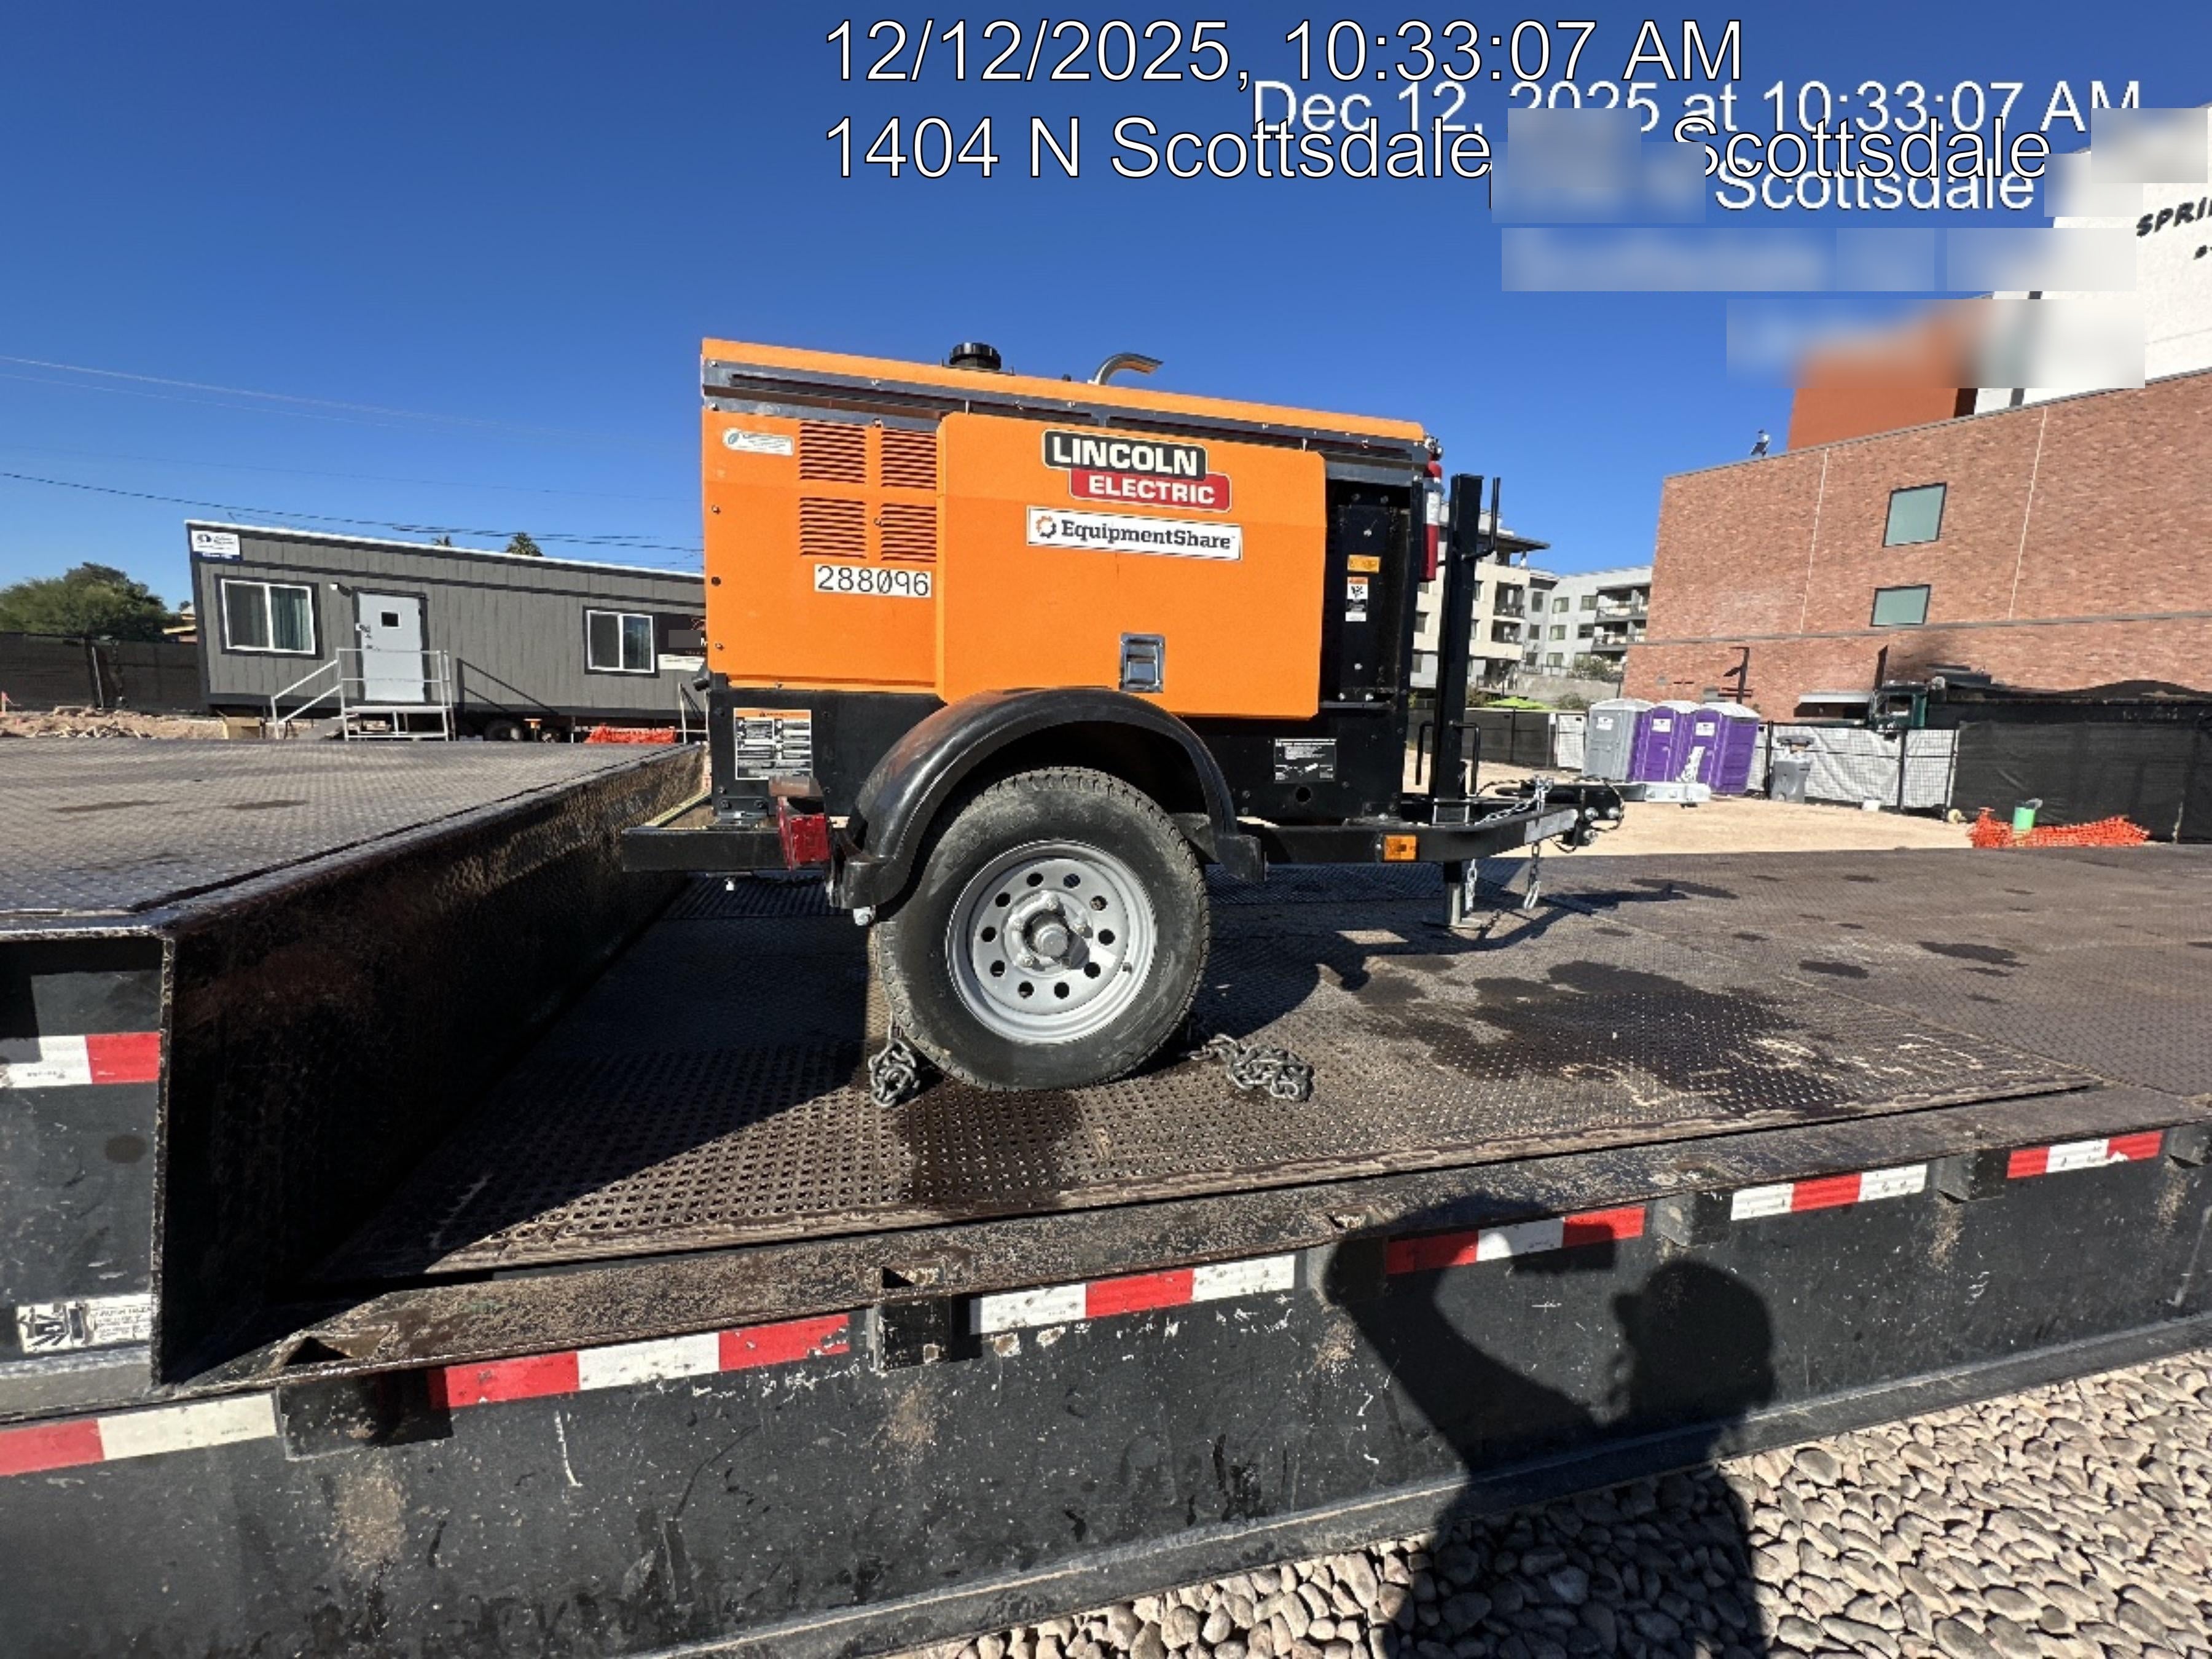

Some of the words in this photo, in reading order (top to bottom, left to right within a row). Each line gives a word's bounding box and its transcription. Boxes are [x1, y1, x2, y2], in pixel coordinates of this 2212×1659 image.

[1052, 436, 1198, 476] LINCOLN
[1088, 474, 1215, 504] ELECTRIC
[1061, 519, 1231, 549] EquipmentShare
[818, 565, 928, 596] 288096
